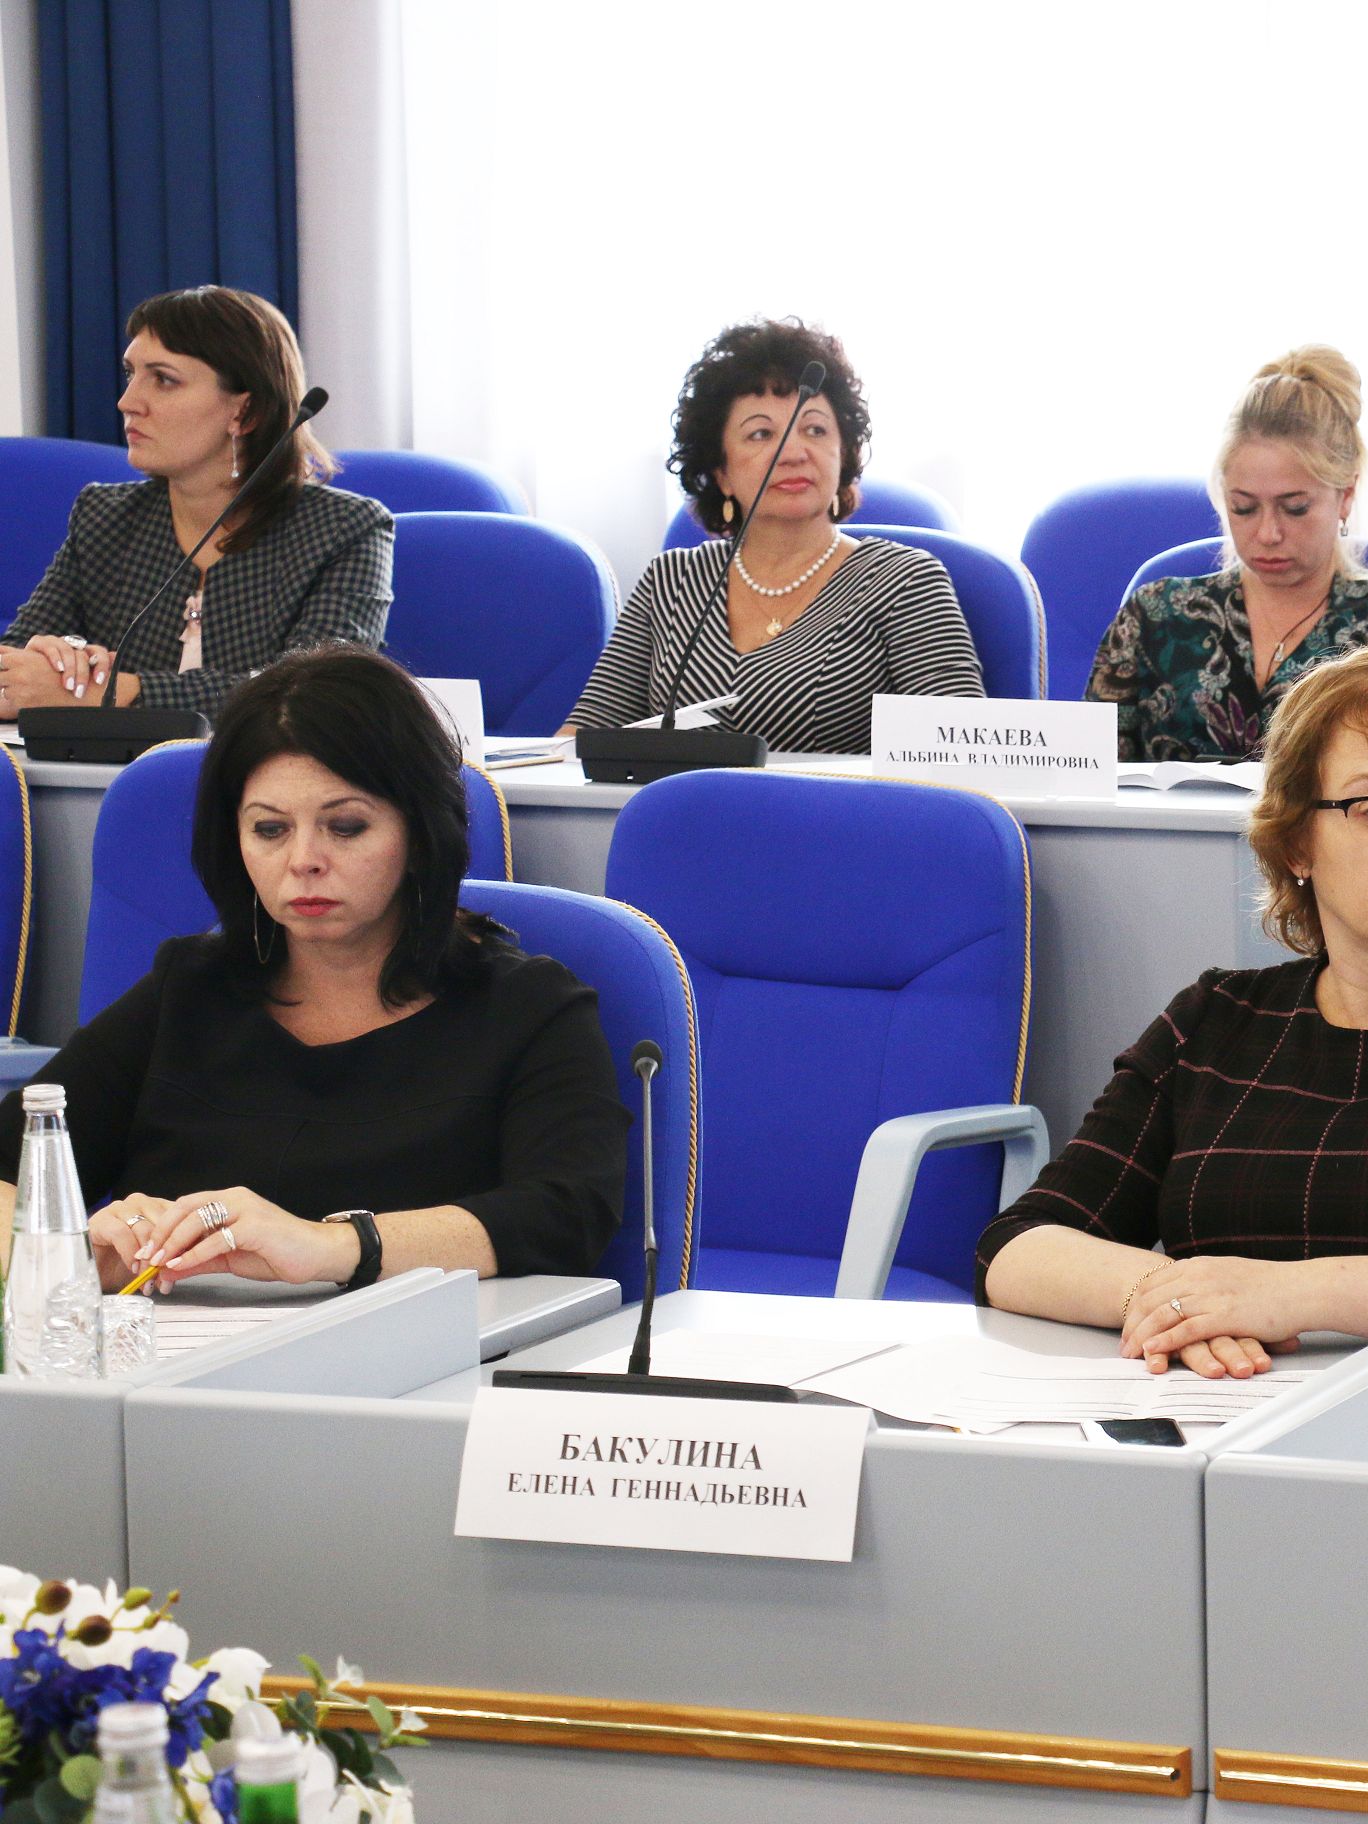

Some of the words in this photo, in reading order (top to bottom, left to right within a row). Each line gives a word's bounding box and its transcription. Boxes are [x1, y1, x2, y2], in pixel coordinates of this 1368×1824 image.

[936, 726, 1048, 747] МАКАЕВА
[886, 750, 959, 764] АЛЬБИНА
[968, 752, 1100, 770] ВЛАДИМИРОВНА
[559, 1433, 764, 1471] БАКУЛИНА
[507, 1472, 596, 1497] ЕЛЕНА
[610, 1478, 808, 1510] ГЕННАДЬЕВНА
